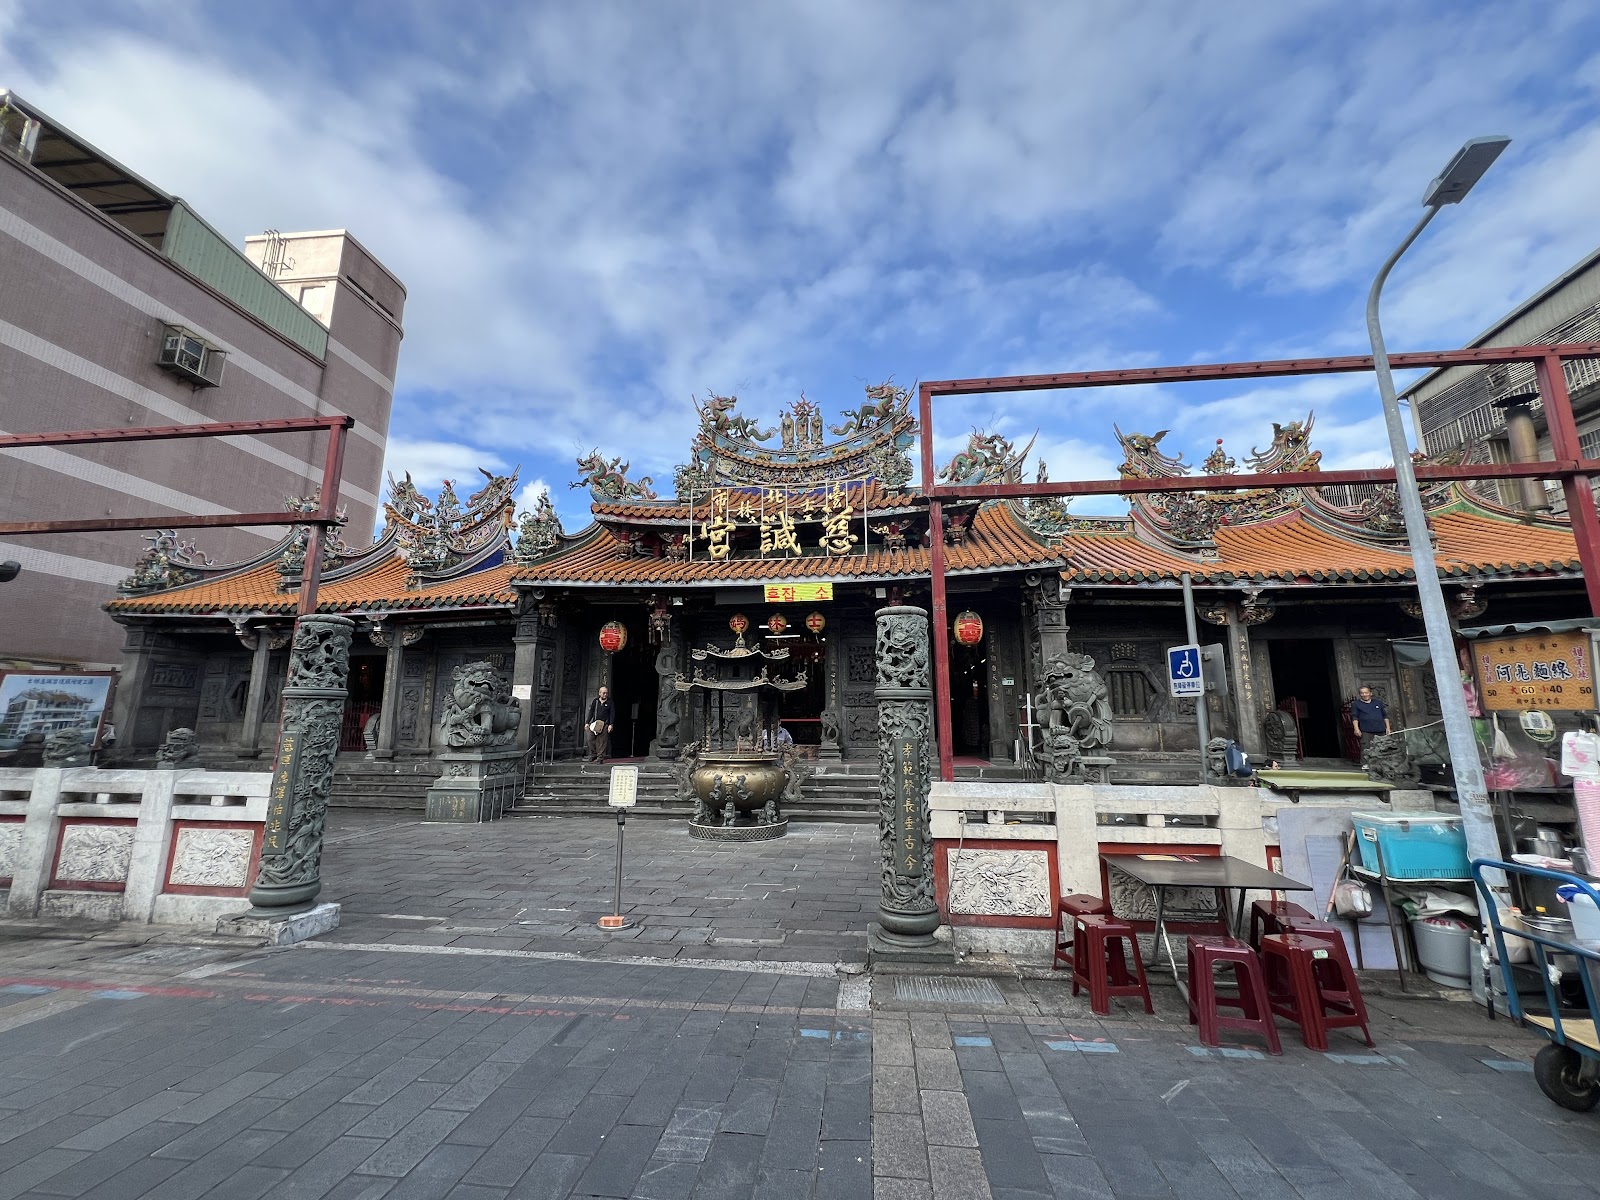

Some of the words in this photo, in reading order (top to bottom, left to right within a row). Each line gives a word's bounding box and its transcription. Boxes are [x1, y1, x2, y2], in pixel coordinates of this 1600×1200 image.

[1494, 659, 1573, 683] 阿亮麵線
[1487, 689, 1497, 697] 50
[1509, 685, 1519, 695] 大
[1521, 686, 1535, 694] 60
[1549, 685, 1563, 693] 40
[1579, 686, 1592, 694] 50
